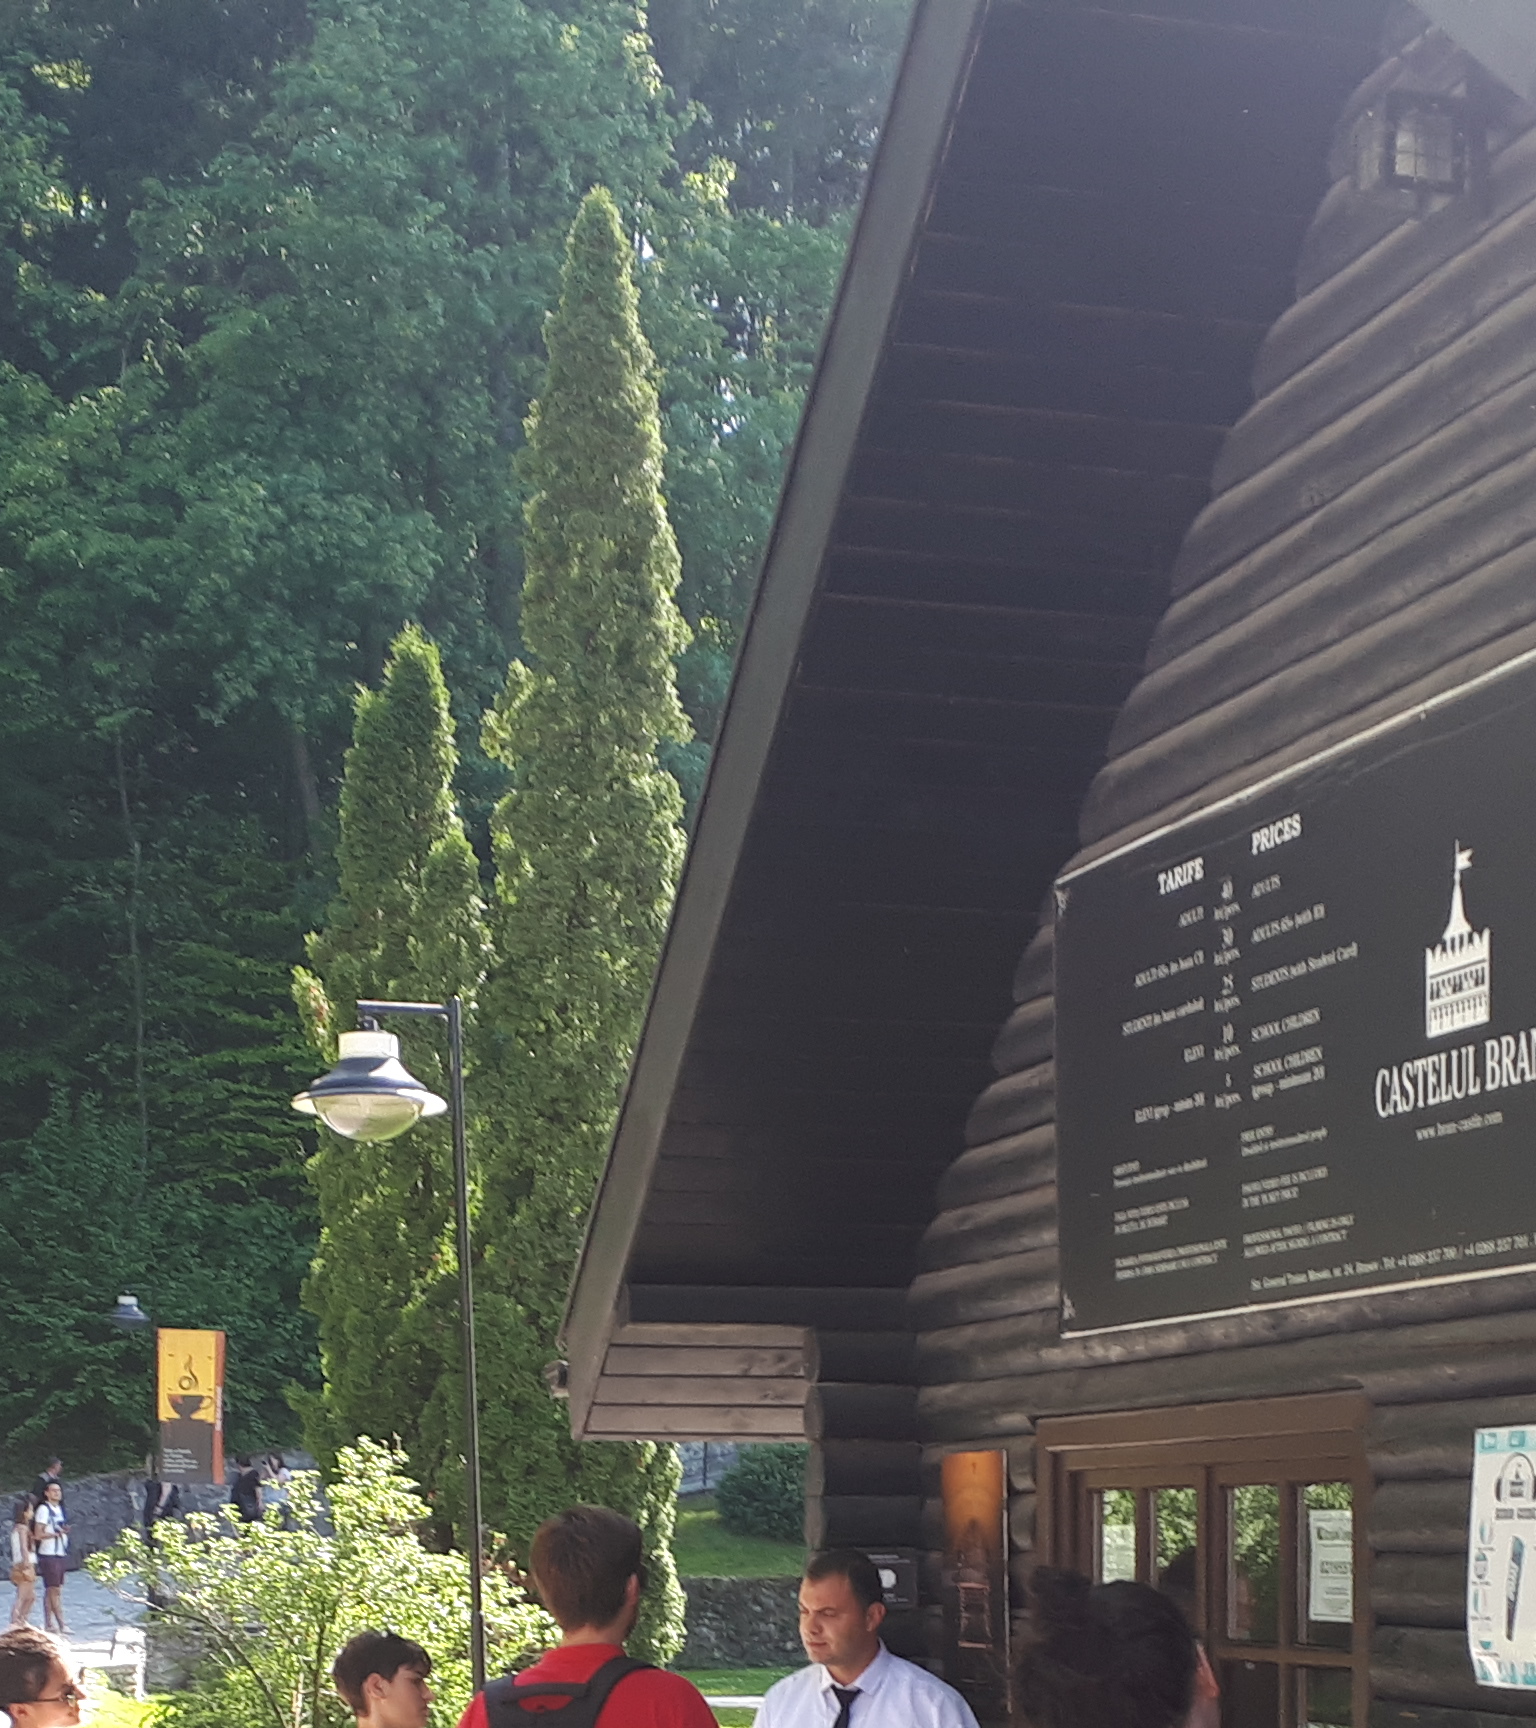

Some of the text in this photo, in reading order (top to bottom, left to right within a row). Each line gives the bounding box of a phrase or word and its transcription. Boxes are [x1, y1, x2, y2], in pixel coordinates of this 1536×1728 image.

[1251, 812, 1302, 855] PRICES
[1157, 856, 1204, 895] TARIFE
[1375, 1045, 1480, 1118] CASTELUL
